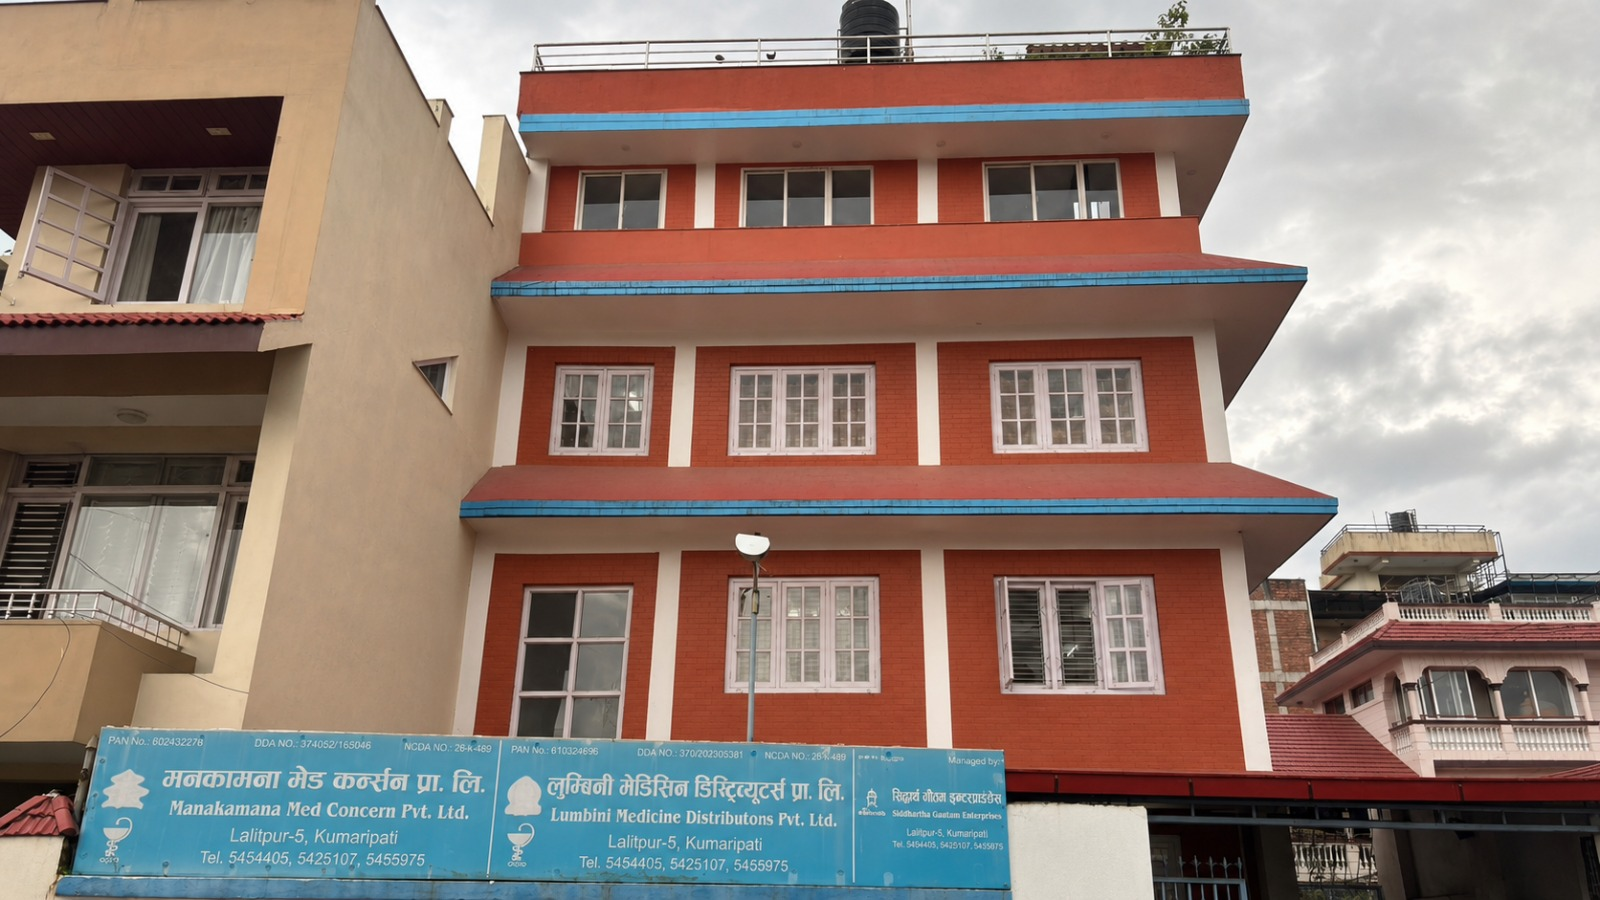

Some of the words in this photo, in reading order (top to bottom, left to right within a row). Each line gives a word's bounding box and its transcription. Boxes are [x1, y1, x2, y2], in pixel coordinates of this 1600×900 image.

[108, 736, 129, 745] PAN
[254, 738, 276, 748] DDA
[404, 742, 431, 752] NCDA
[511, 745, 530, 754] PAN
[637, 748, 656, 757] DDA
[764, 752, 789, 760] NCDA
[948, 756, 986, 766] Managed
[162, 770, 282, 788] मनकामना
[288, 766, 327, 790] मेड
[417, 774, 444, 794] प्रा.
[452, 768, 485, 794] लि.
[547, 772, 614, 800] लुम्बिनी
[619, 774, 689, 798] मेडिसिन
[791, 782, 812, 802] प्रा.
[818, 778, 844, 802] लि.
[169, 800, 280, 816] Manakamana
[286, 801, 322, 817] Med
[326, 802, 396, 818] Concern
[401, 804, 431, 819] Pvt.
[437, 804, 469, 820] Ltd.
[892, 810, 930, 818] Siddhartha
[962, 811, 1002, 821] Enterprises
[551, 807, 611, 822] Lumbini
[616, 809, 681, 824] Medicine
[778, 812, 804, 827] Pvt.
[809, 813, 837, 827] Ltd.
[230, 827, 308, 846] Lalitpur-5,
[314, 829, 398, 848] Kumaripati
[947, 829, 988, 840] Kumaripati
[608, 834, 680, 852] Lalitpur-5,
[686, 836, 762, 853] Kumaripati
[201, 850, 223, 864] Tel.
[228, 851, 292, 867] 5454405,
[297, 852, 360, 868] 5425107,
[366, 853, 425, 866] 5455975
[579, 855, 600, 869] Tel.
[606, 856, 665, 871] 5454405,
[670, 858, 729, 873] 5425107,
[734, 859, 788, 872] 5455975
